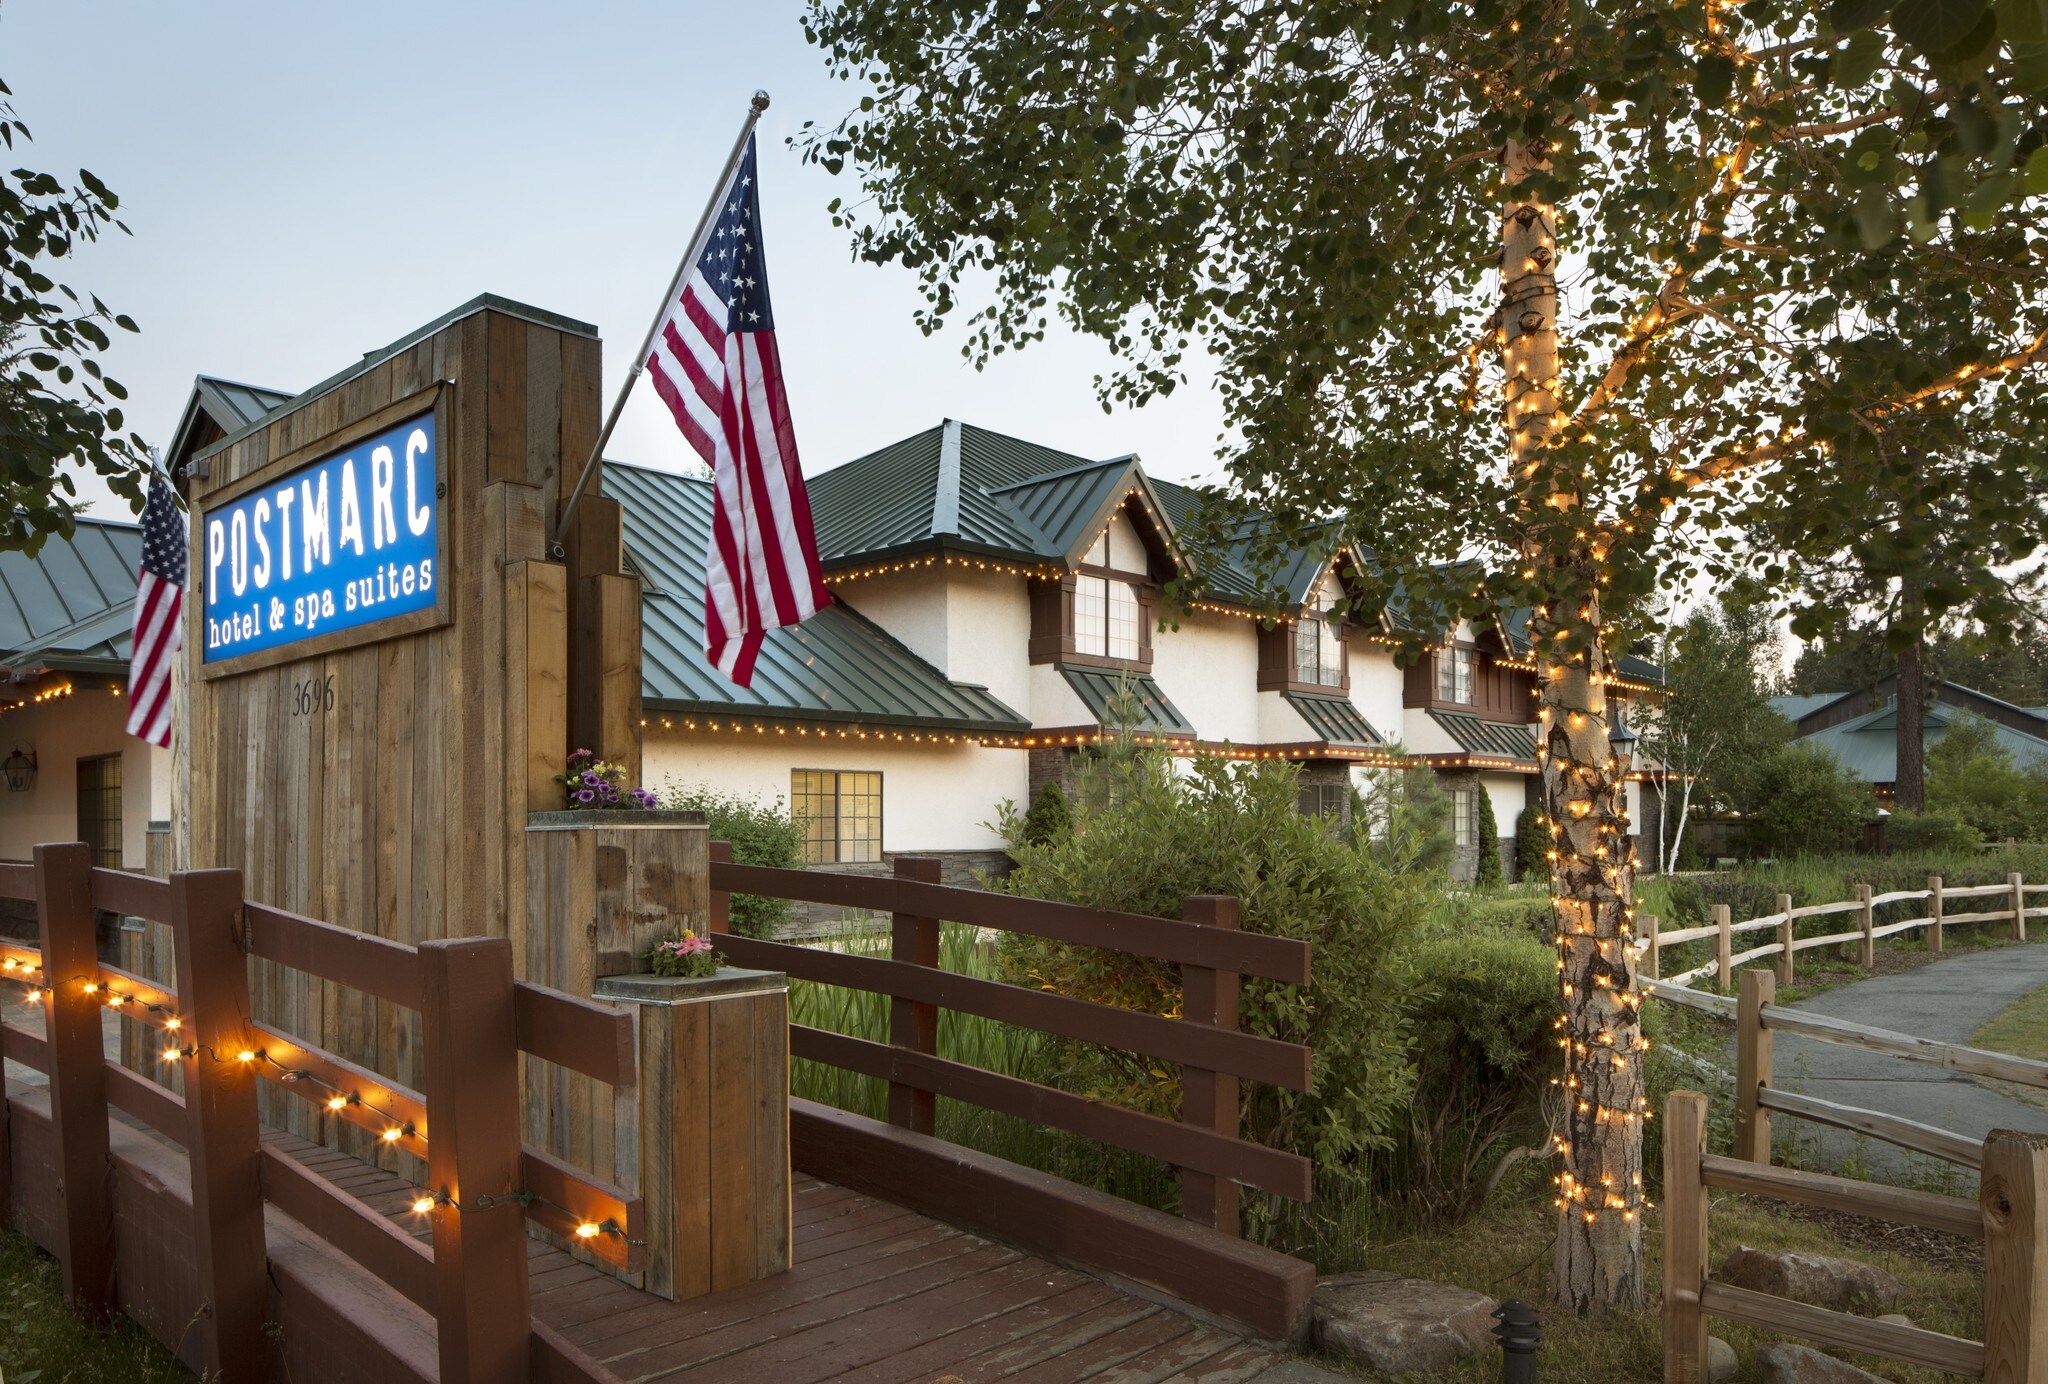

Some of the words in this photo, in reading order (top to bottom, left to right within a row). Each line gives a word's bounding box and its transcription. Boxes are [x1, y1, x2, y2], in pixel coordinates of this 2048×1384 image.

[209, 428, 430, 605] POSTMARC
[209, 603, 260, 649] hotel
[269, 597, 285, 631] &
[294, 589, 335, 629] spa
[346, 558, 432, 611] suites
[292, 675, 335, 717] 3696
